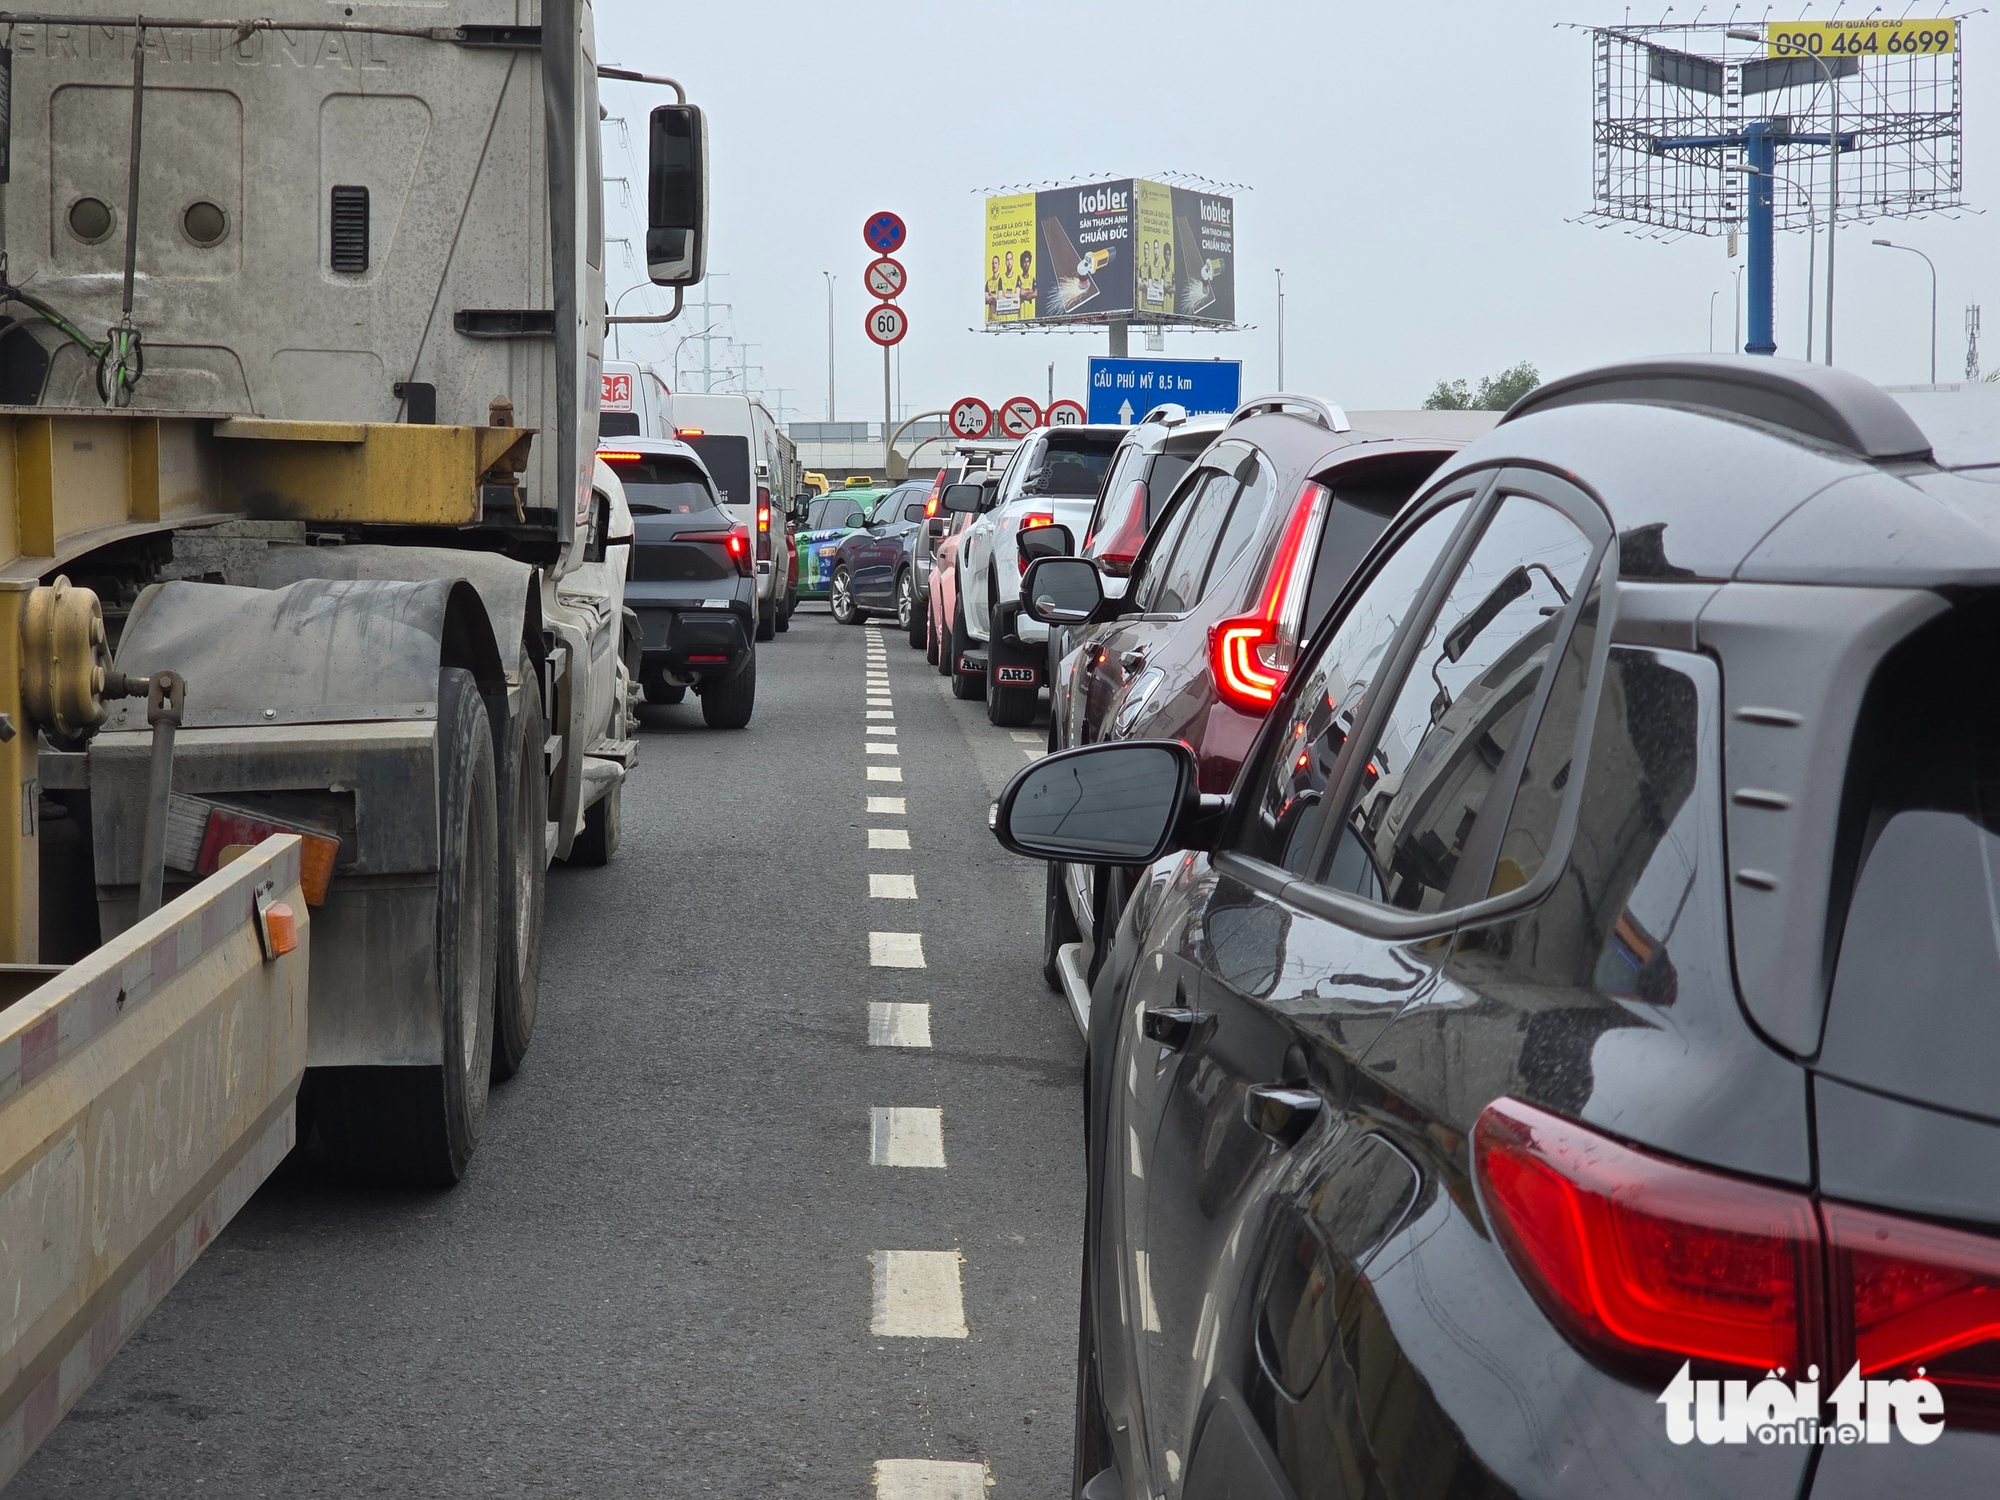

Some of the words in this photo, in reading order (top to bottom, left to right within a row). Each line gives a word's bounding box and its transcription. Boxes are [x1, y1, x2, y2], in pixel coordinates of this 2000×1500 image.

[1776, 32, 1823, 55] 090
[1831, 31, 1878, 54] 464
[1887, 30, 1949, 53] 6699
[1079, 187, 1128, 214] kobler
[1200, 199, 1231, 224] kobler
[1080, 218, 1091, 229] SÀN
[1092, 216, 1113, 228] THẠCH
[1114, 215, 1128, 224] ANH
[1110, 225, 1128, 240] ĐỨC
[878, 315, 895, 333] 60
[1094, 367, 1112, 387] CẦU
[1116, 370, 1135, 388] PHÚ
[1140, 371, 1154, 389] MỸ
[1158, 375, 1173, 390] 8,5
[1177, 375, 1192, 390] km
[1056, 412, 1076, 425] 50
[1000, 668, 1033, 681] ARB
